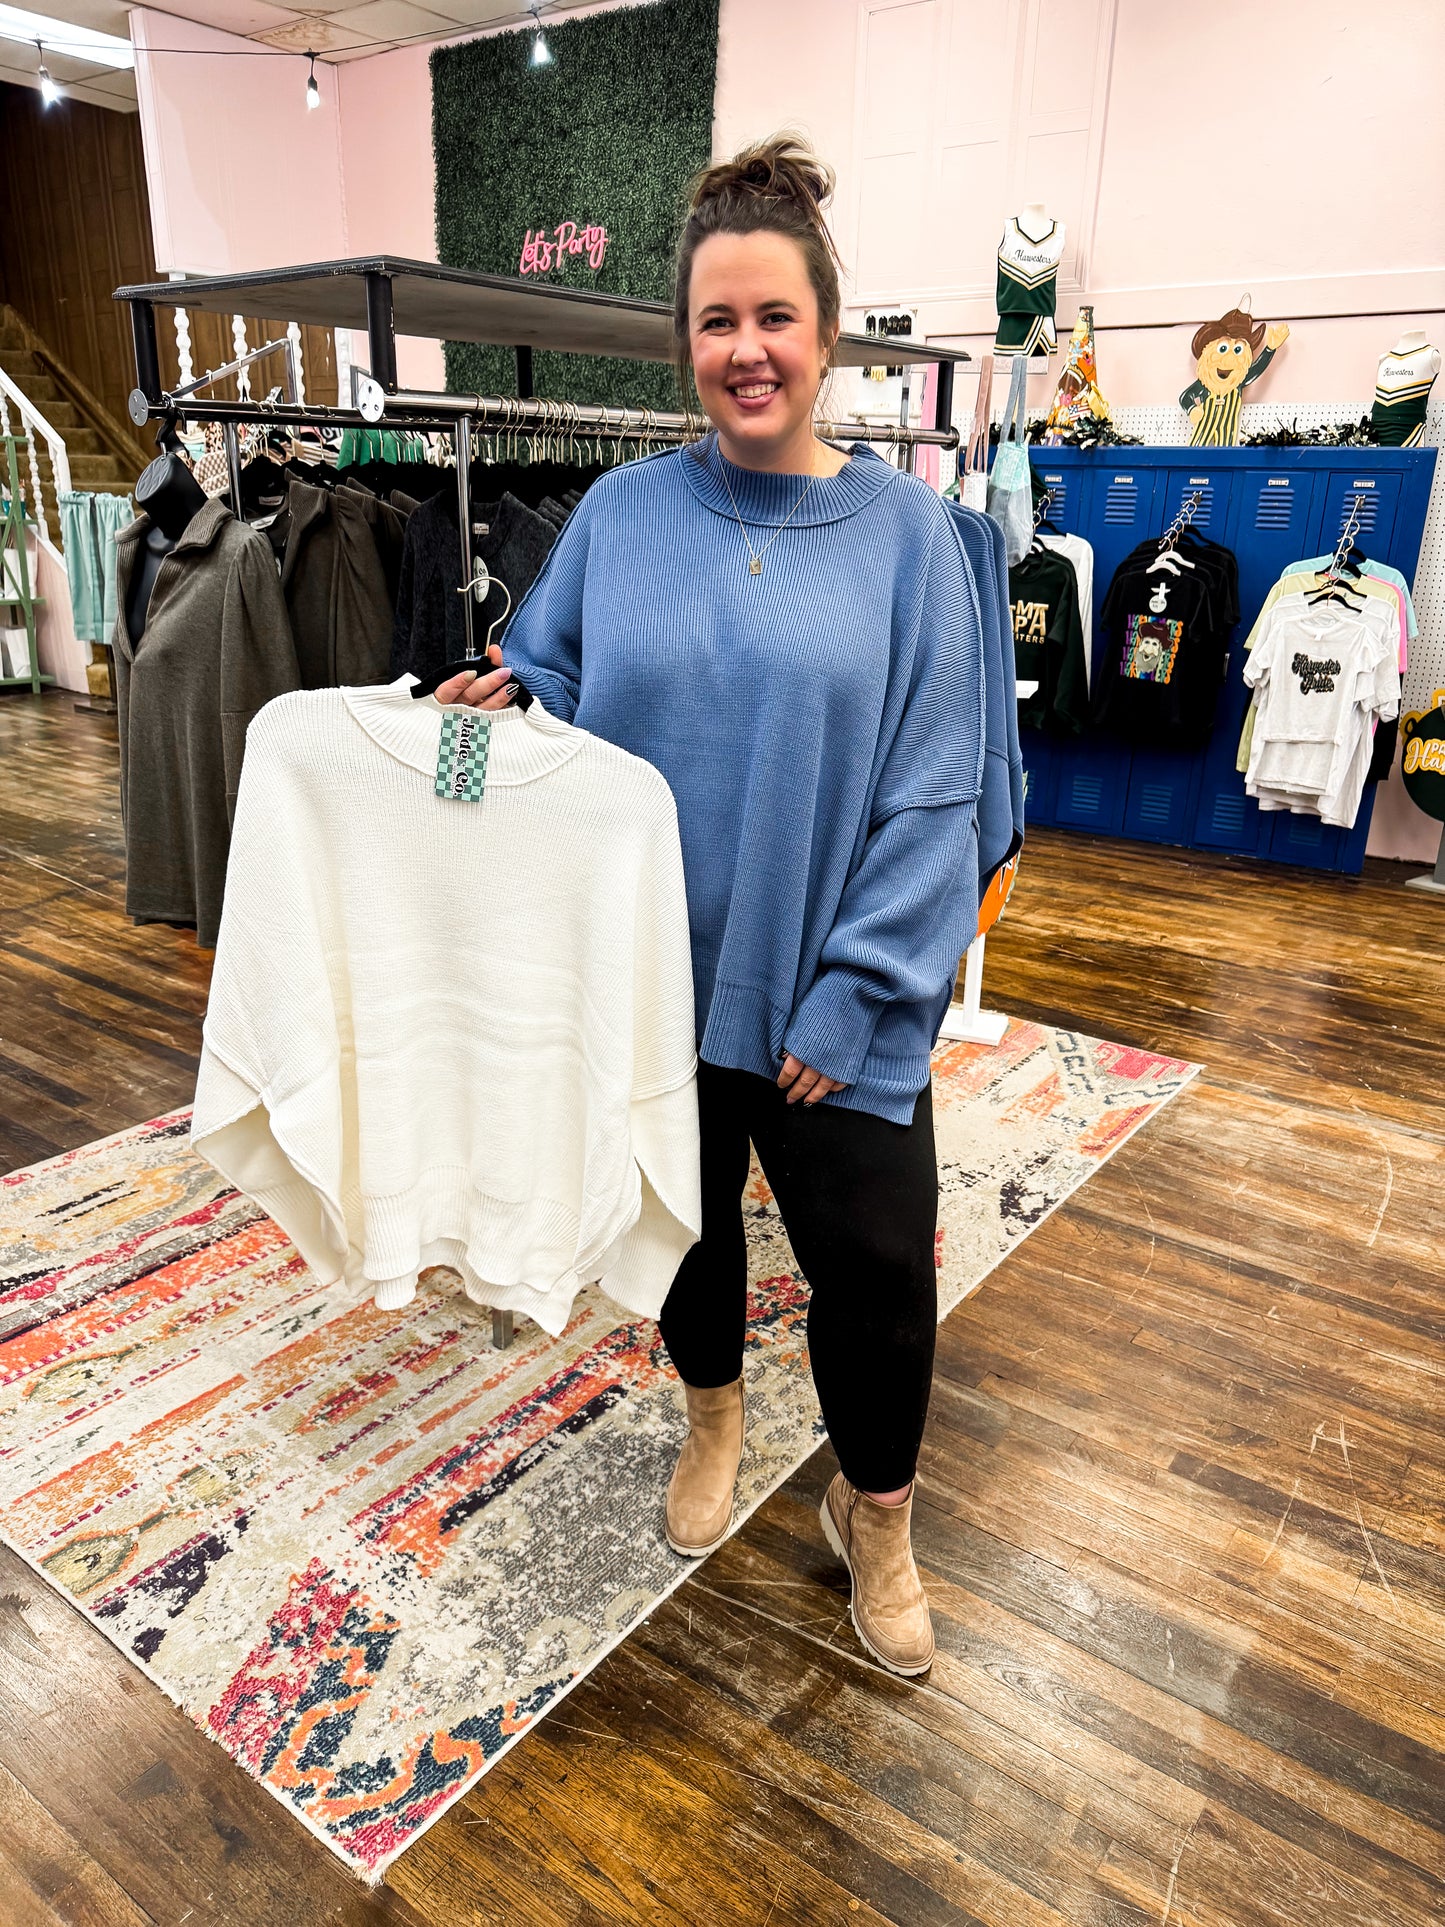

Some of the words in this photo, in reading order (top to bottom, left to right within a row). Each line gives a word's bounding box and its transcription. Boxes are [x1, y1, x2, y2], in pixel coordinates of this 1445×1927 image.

[520, 229, 557, 274] Let's
[553, 221, 609, 269] Party
[1011, 249, 1052, 264] Harvesters
[457, 717, 476, 760] Jade
[453, 771, 469, 796] Co.
